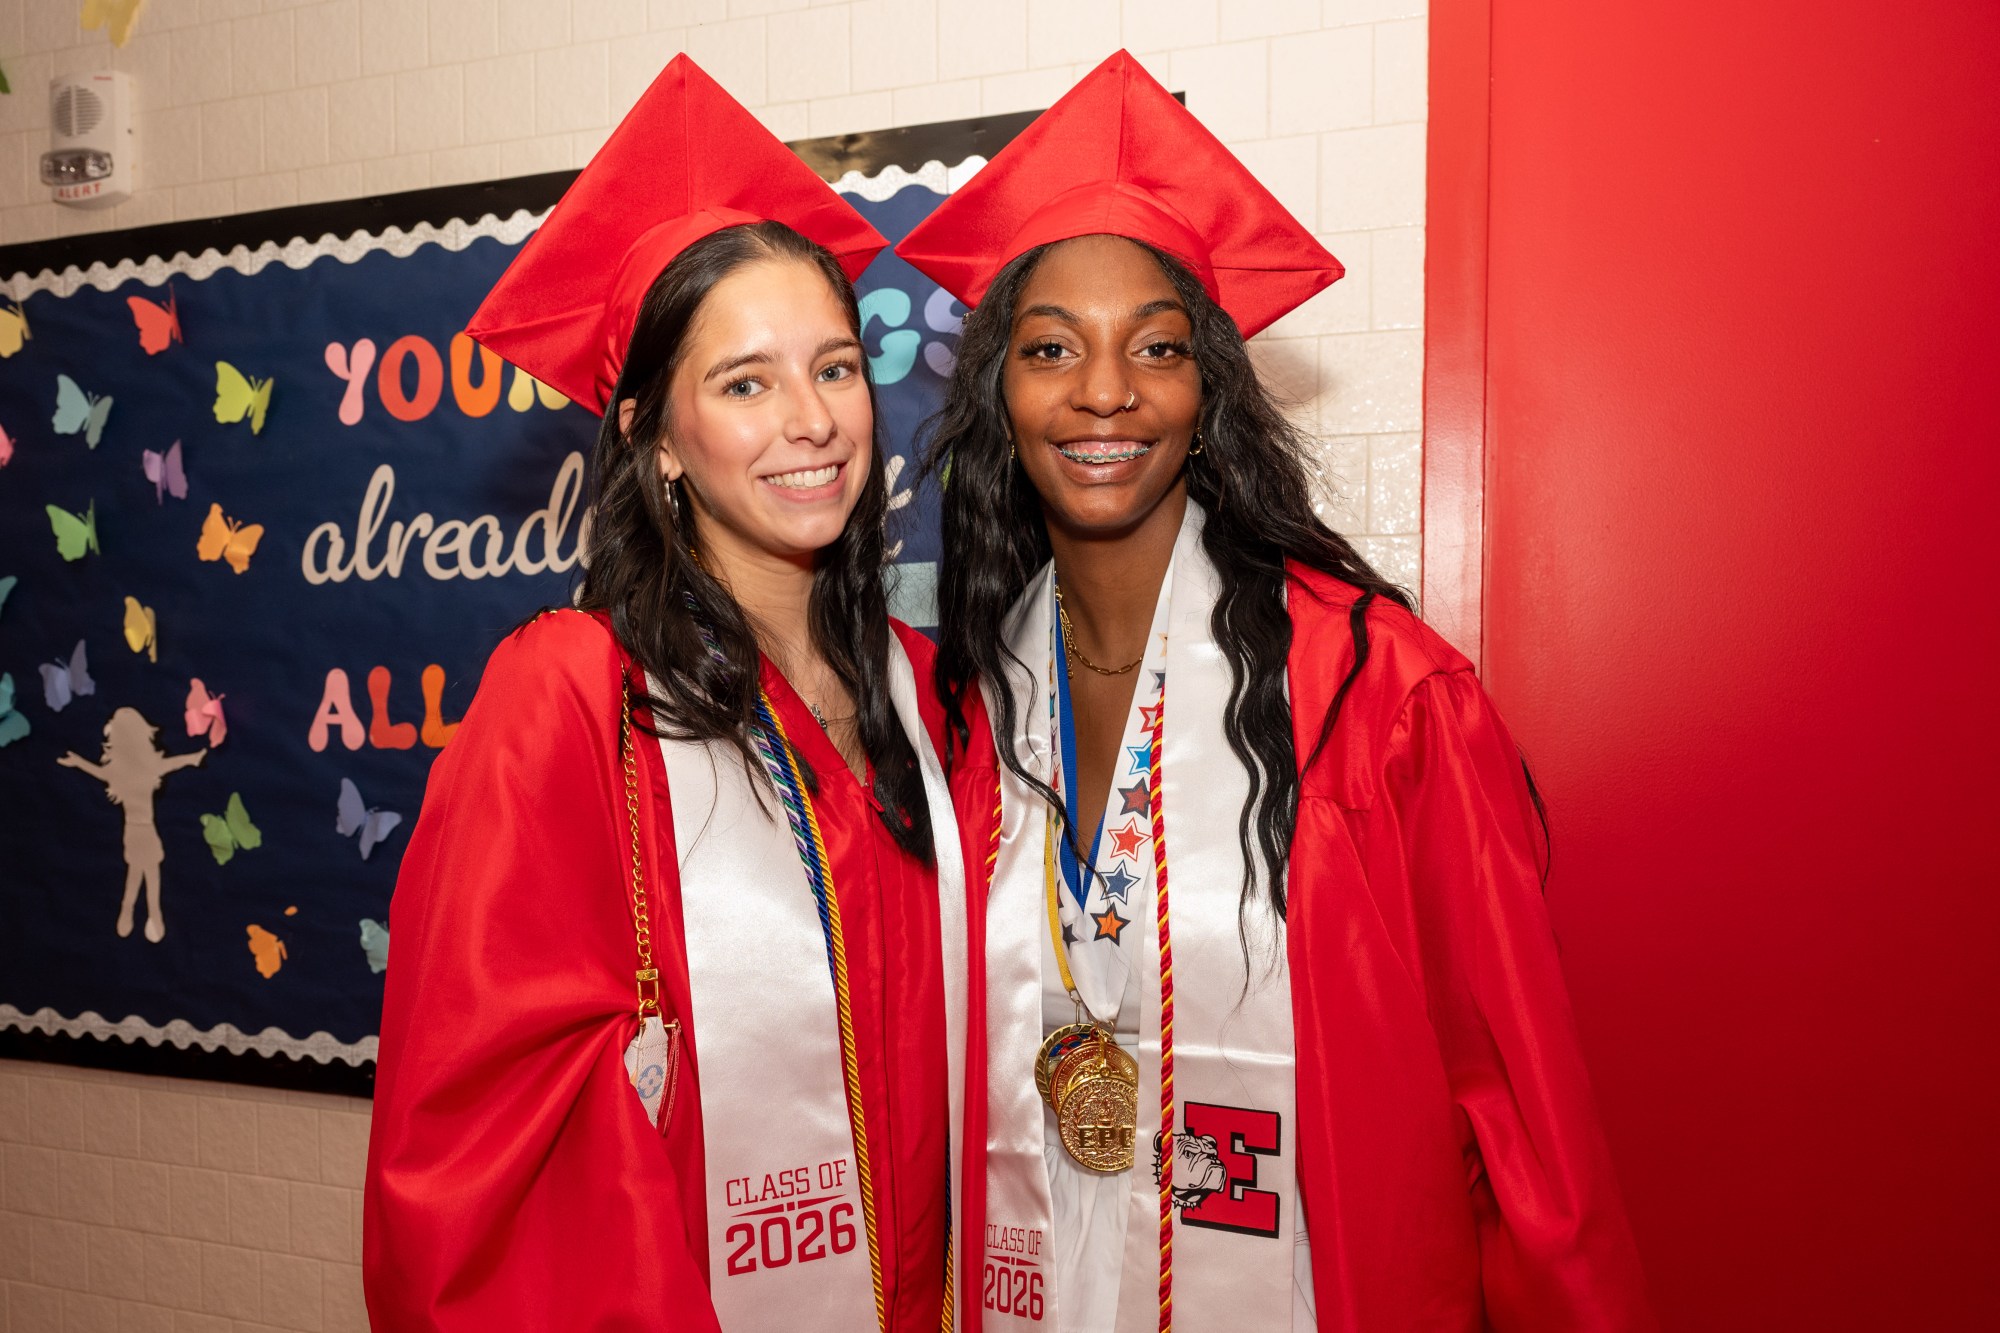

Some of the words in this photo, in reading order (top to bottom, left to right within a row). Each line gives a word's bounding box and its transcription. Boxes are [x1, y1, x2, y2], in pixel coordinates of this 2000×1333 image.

[58, 181, 101, 198] ALERT
[308, 663, 463, 753] ALL
[726, 1167, 810, 1207] CLASS
[818, 1159, 847, 1190] OF
[1180, 1100, 1281, 1239] E
[725, 1202, 857, 1277] 2026
[986, 1224, 1025, 1253] CLASS
[1028, 1229, 1043, 1255] OF
[984, 1263, 1044, 1321] 2026
